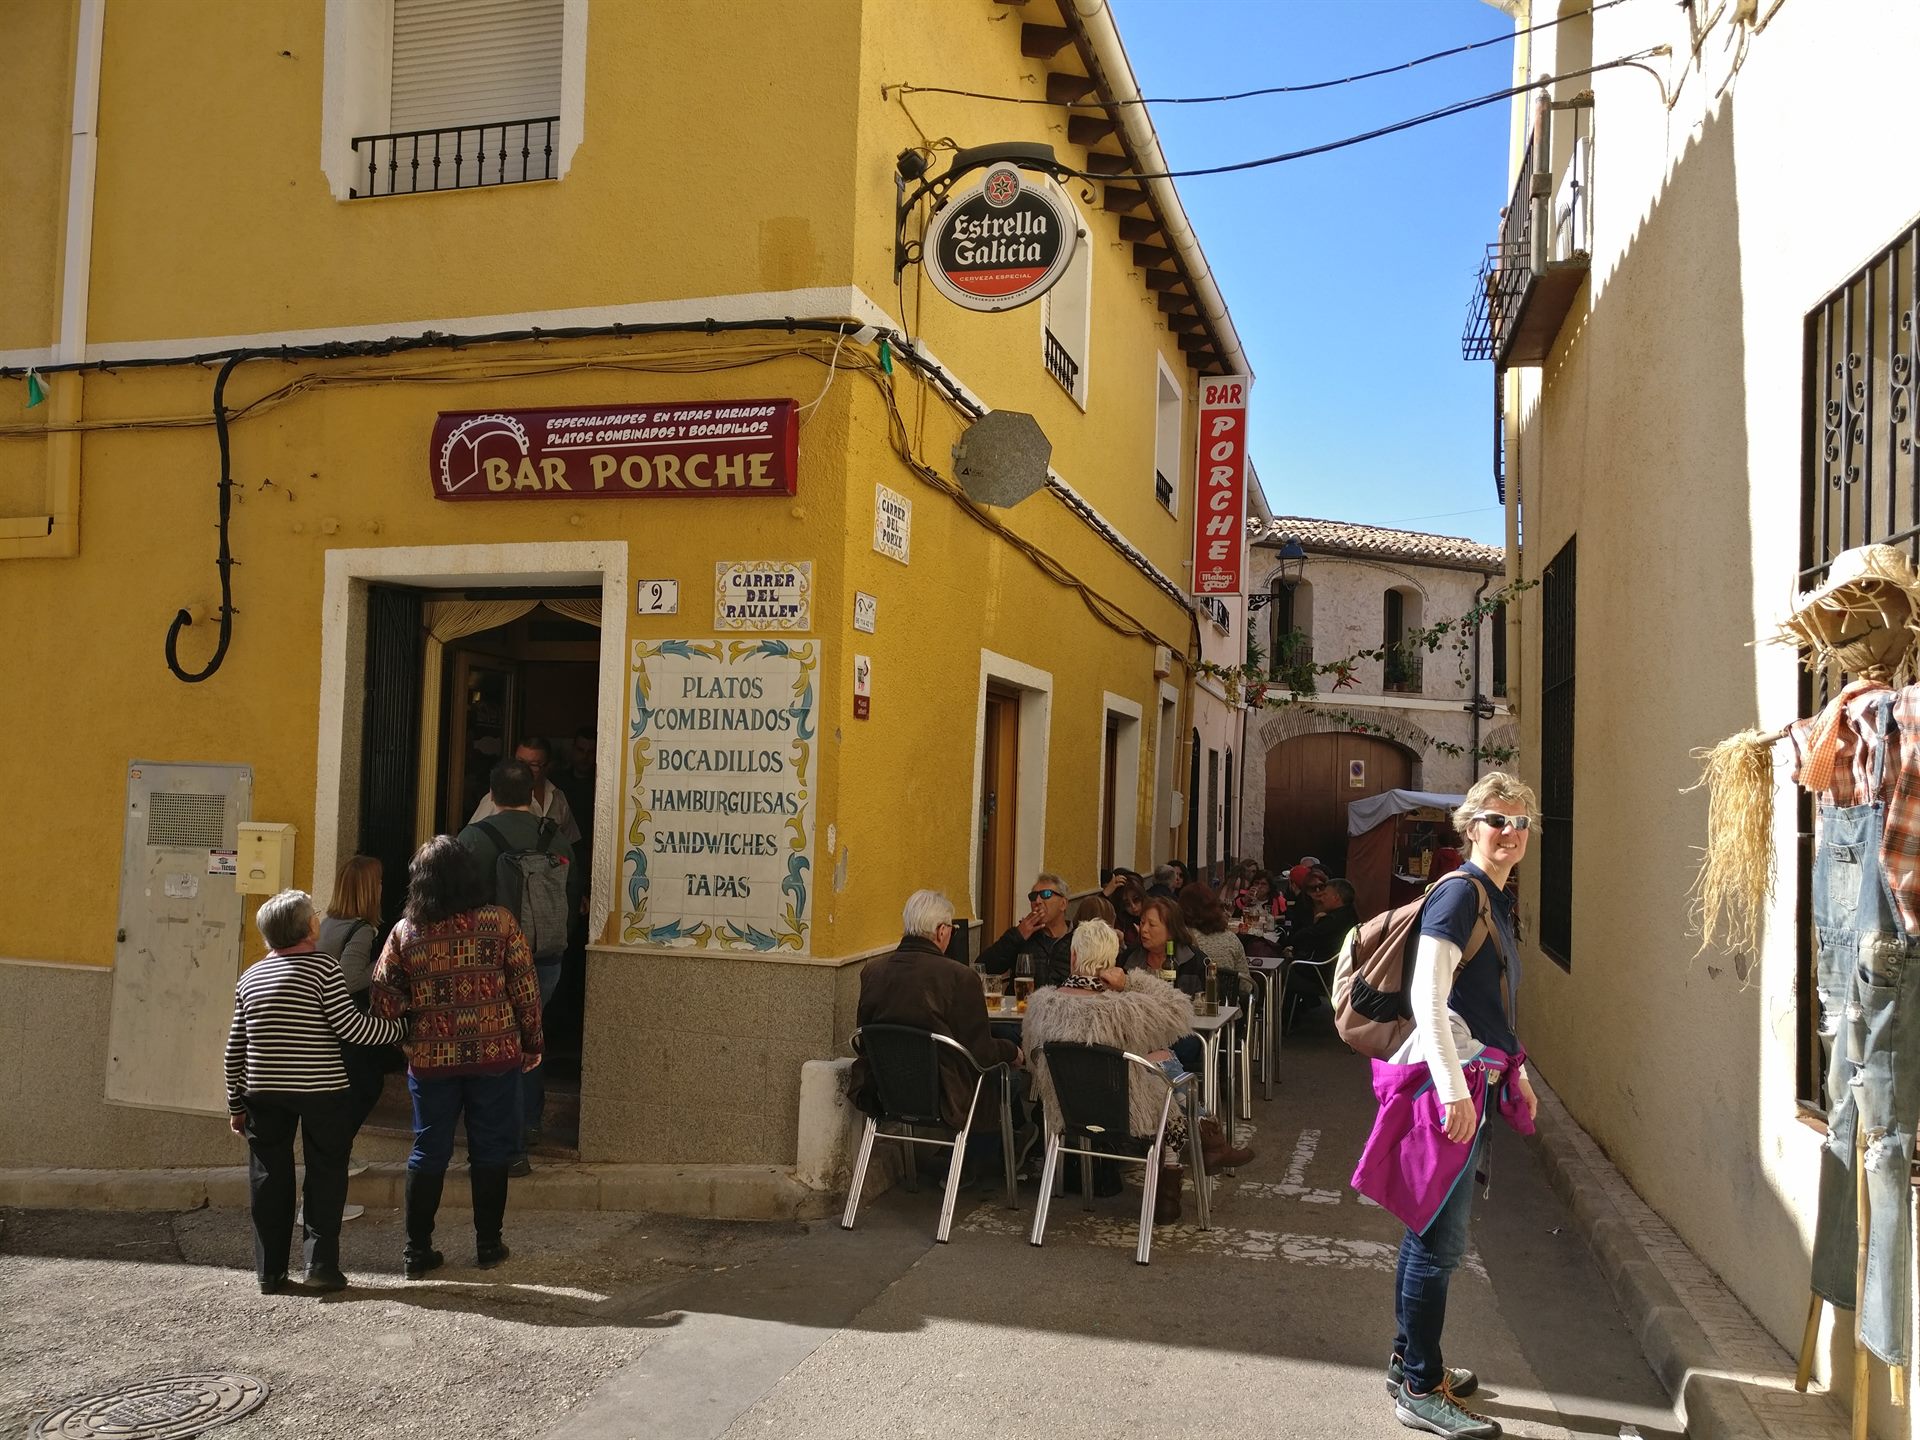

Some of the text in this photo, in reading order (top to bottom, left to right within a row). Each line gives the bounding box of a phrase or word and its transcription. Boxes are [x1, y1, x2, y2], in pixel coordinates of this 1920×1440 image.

[951, 211, 1047, 240] Estrella
[955, 237, 1042, 266] Galicia
[959, 274, 994, 282] CERVEZA
[1205, 383, 1242, 405] BAR
[546, 406, 776, 430] ESPECIALIDADES EN TAPAS VARIADAS
[547, 420, 768, 445] PLATOS COMBINADOS Y BOCADILLOS
[482, 453, 573, 492] BAR
[590, 452, 775, 490] PORCHE
[1205, 416, 1236, 561] PORCHE
[882, 499, 906, 522] CARRER
[886, 515, 900, 534] DEL
[882, 529, 903, 549] PORXE
[732, 573, 795, 588] CARRER
[651, 583, 663, 610] 2
[746, 589, 779, 603] DEL
[725, 604, 799, 618] RAVALET
[681, 676, 764, 699] PLATOS
[653, 707, 791, 731] COMBINADOS
[657, 749, 783, 773] BOCADILLOS
[650, 789, 798, 816] HAMBURGUESAS
[653, 831, 778, 856] SANDWICHES
[685, 873, 751, 898] TAPAS
